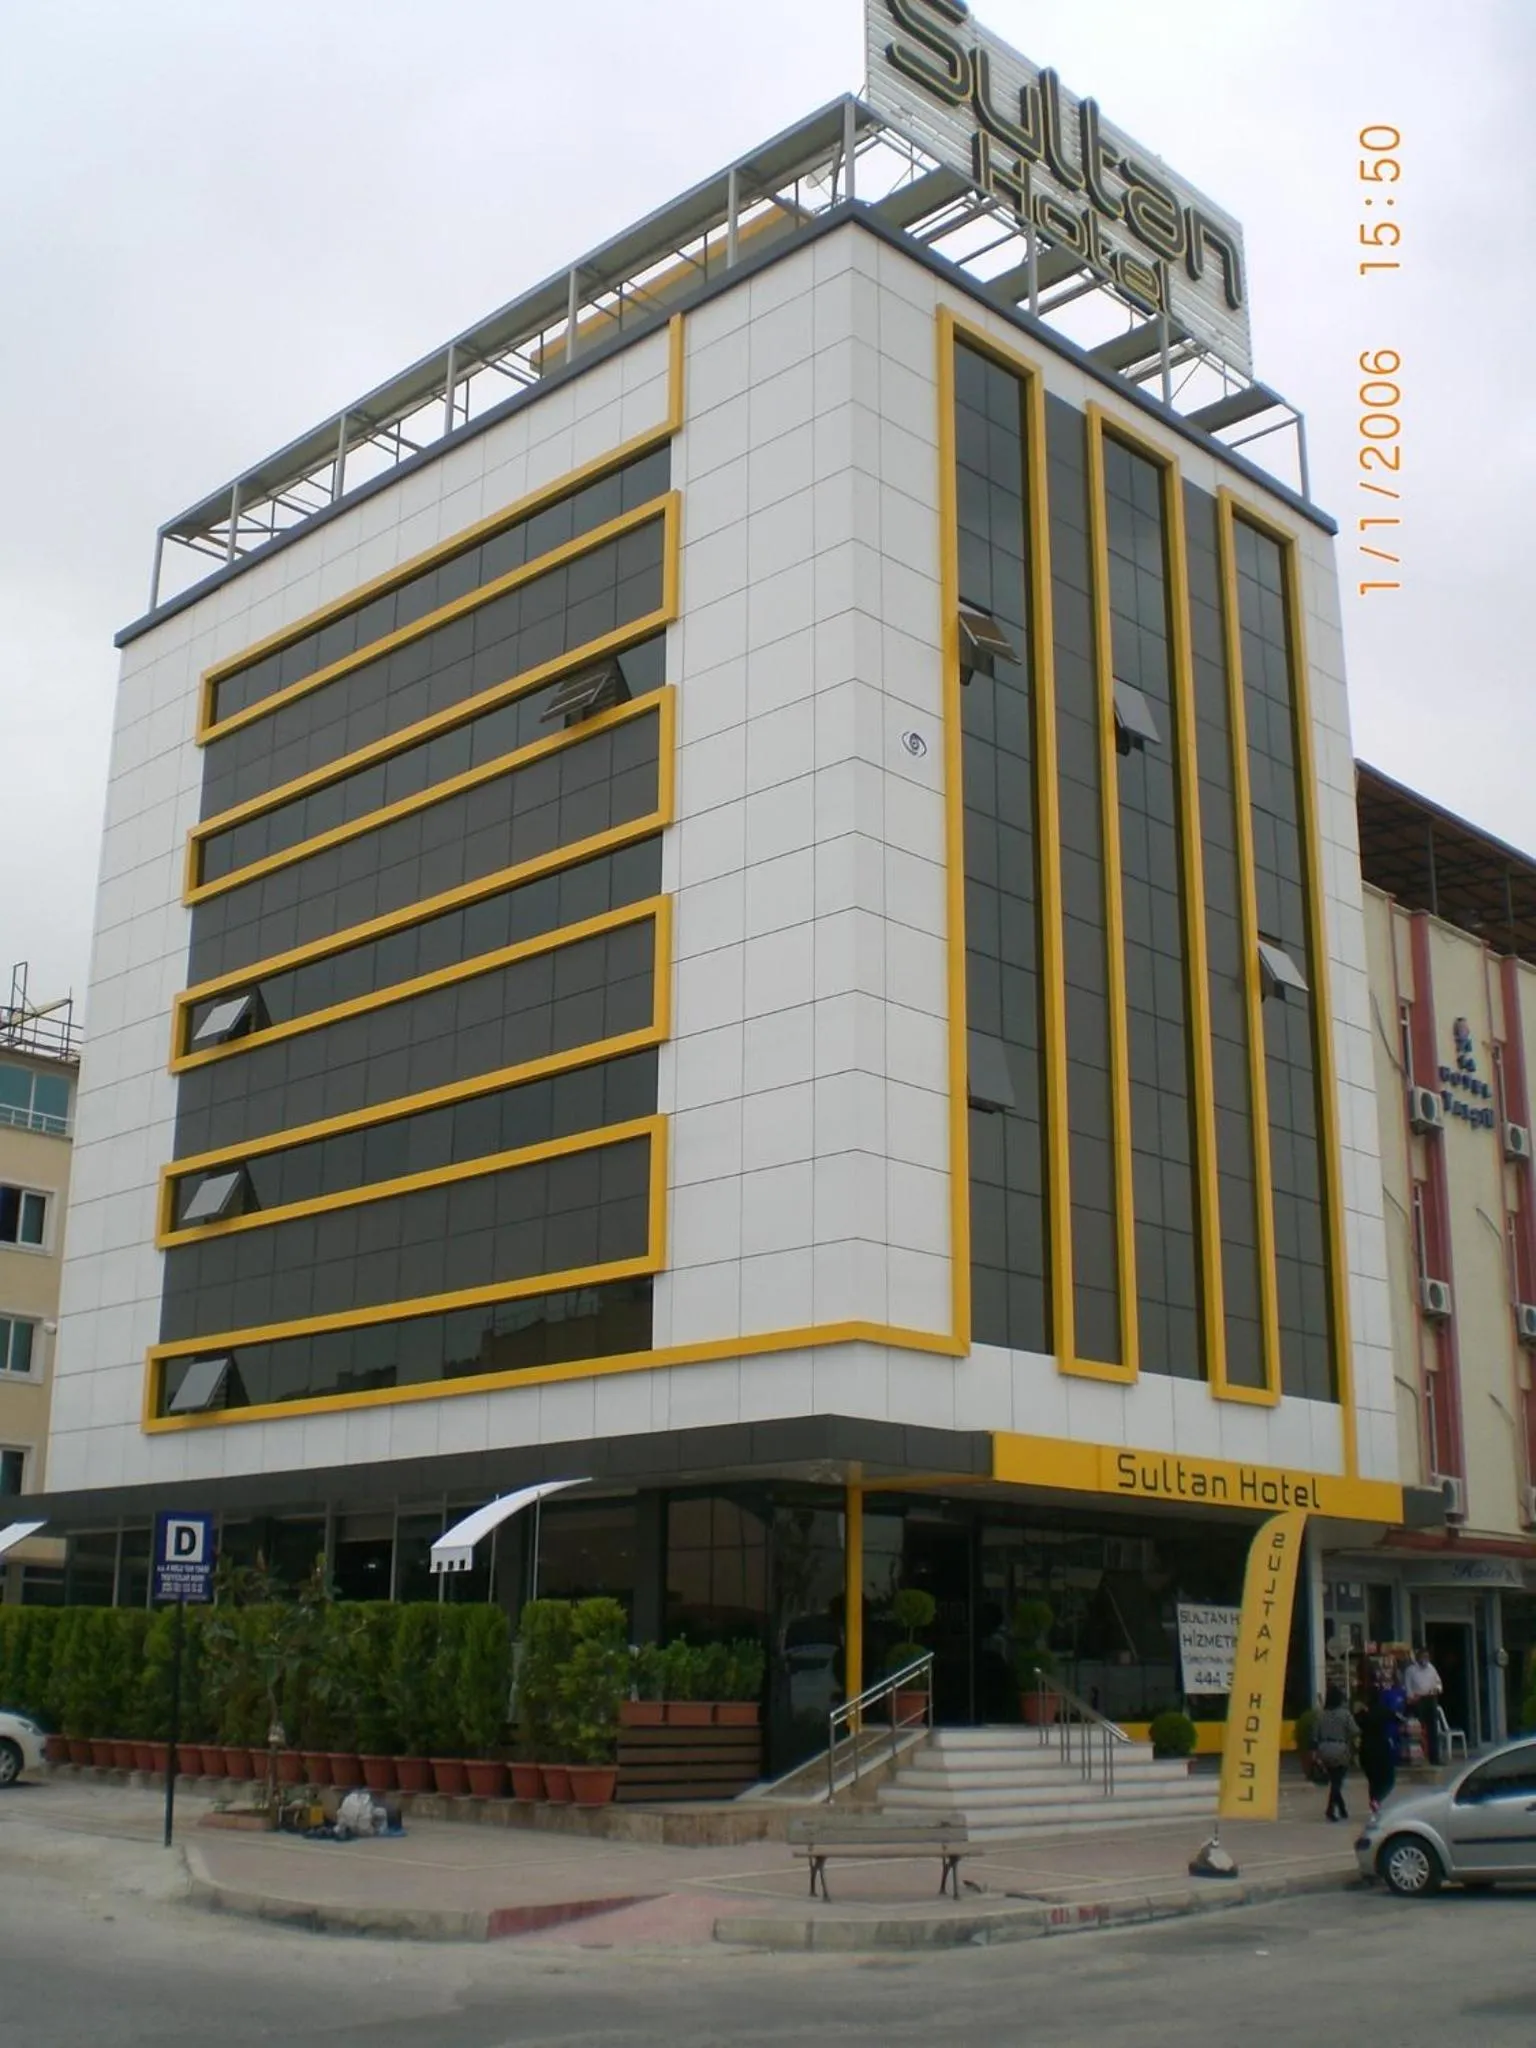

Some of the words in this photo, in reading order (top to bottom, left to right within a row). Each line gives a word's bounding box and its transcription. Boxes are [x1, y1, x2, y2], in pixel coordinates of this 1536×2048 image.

[885, 0, 1241, 310] Sultan
[971, 129, 1174, 322] Hotel
[1117, 1453, 1227, 1498] Sultan
[1240, 1467, 1320, 1508] Hotel
[174, 1526, 197, 1556] D
[1180, 1609, 1228, 1625] SULTAN
